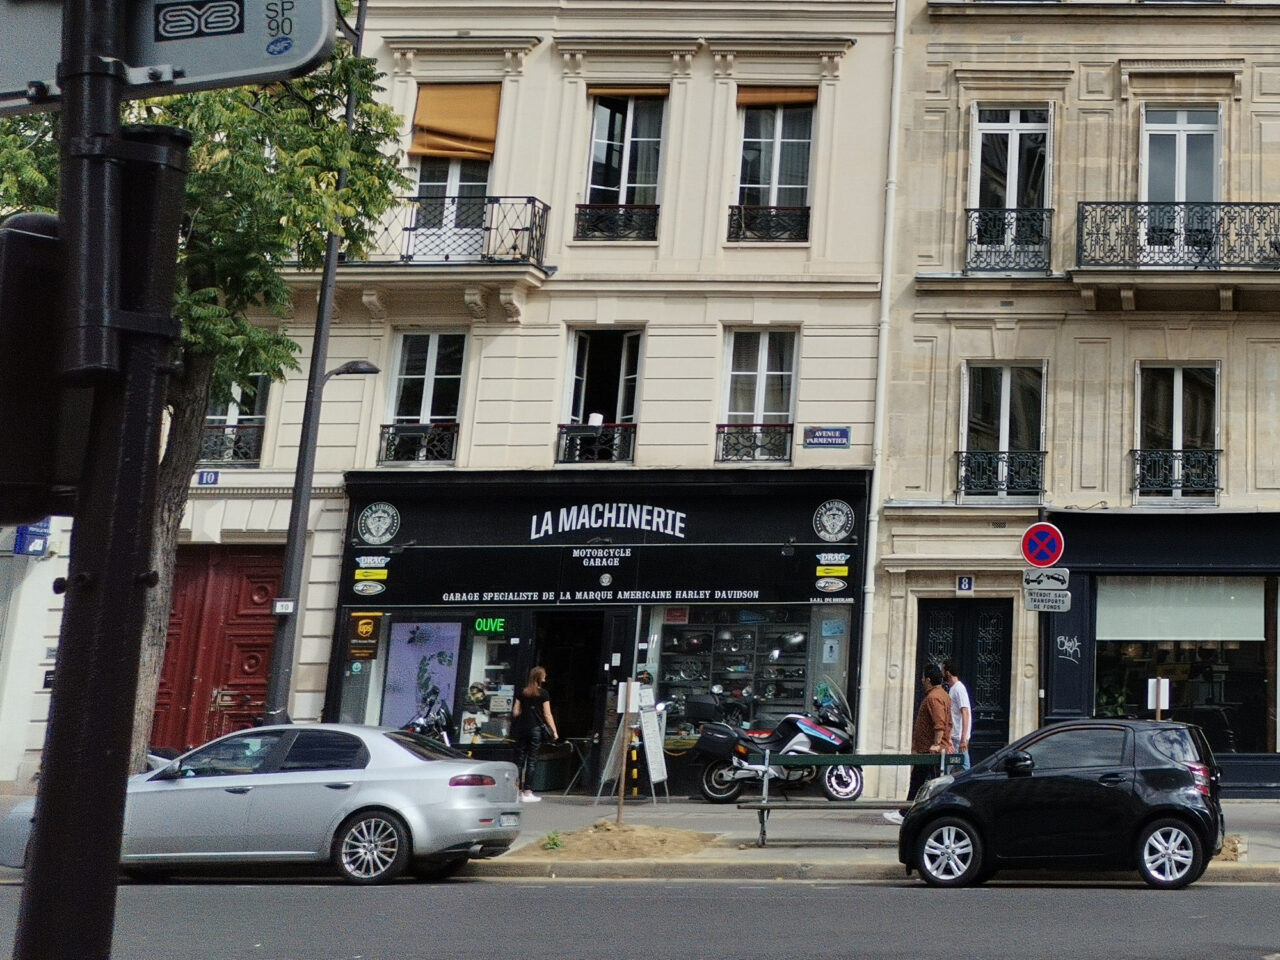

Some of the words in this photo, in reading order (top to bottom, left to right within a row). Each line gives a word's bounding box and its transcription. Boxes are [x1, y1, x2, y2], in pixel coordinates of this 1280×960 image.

[265, 0, 295, 19] SP
[267, 17, 293, 37] 90
[202, 472, 215, 484] 10
[530, 511, 553, 540] LA
[558, 503, 687, 538] MACHINERIE
[572, 548, 631, 557] MOTORCYCLE
[583, 557, 620, 566] GARAGE
[961, 577, 969, 590] 8
[442, 592, 480, 601] GARAGE
[483, 592, 539, 600] SPECIALISTE
[542, 592, 555, 600] DE
[560, 592, 571, 600] LA
[575, 591, 613, 601] MARQUE
[617, 591, 672, 599] AMERICAINE
[675, 590, 711, 599] HARLEY
[715, 590, 759, 599] DAVIDSON
[475, 618, 505, 632] OUVE
